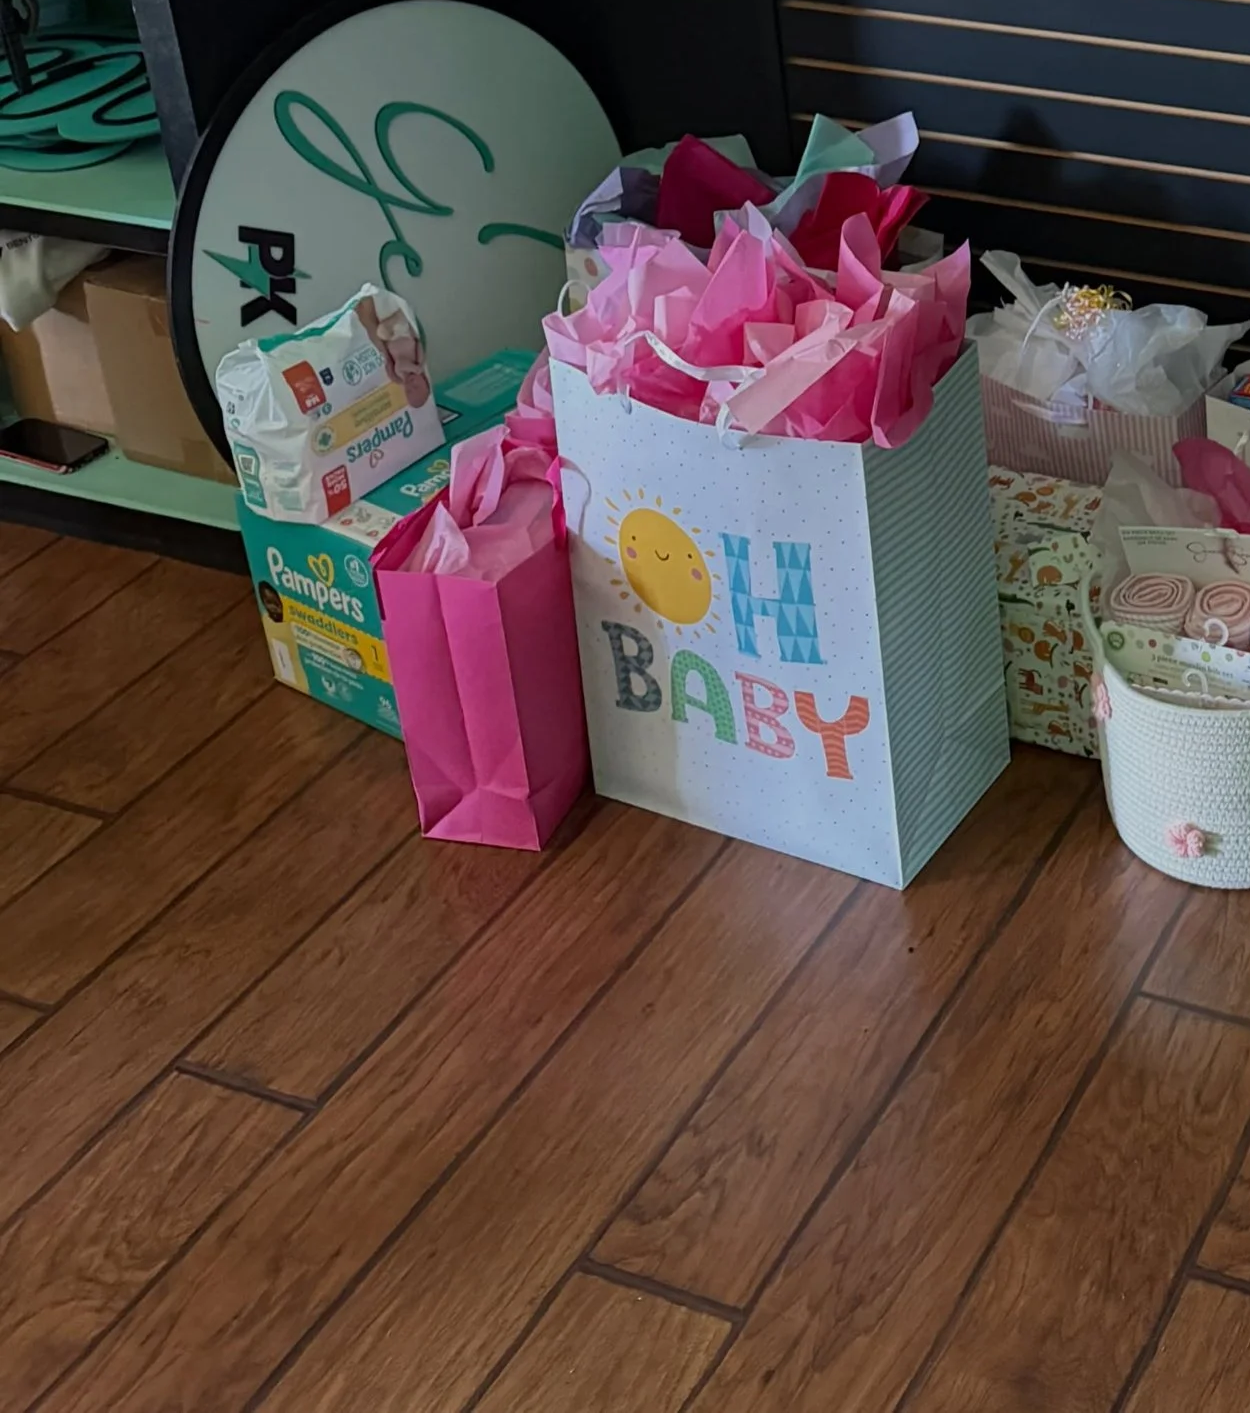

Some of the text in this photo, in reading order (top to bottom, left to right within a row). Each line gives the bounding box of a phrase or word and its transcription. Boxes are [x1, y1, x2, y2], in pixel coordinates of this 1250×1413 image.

[345, 410, 414, 464] Pampers
[267, 546, 364, 623] Pampers
[288, 605, 358, 645] swaddlers
[601, 619, 871, 781] BABY
